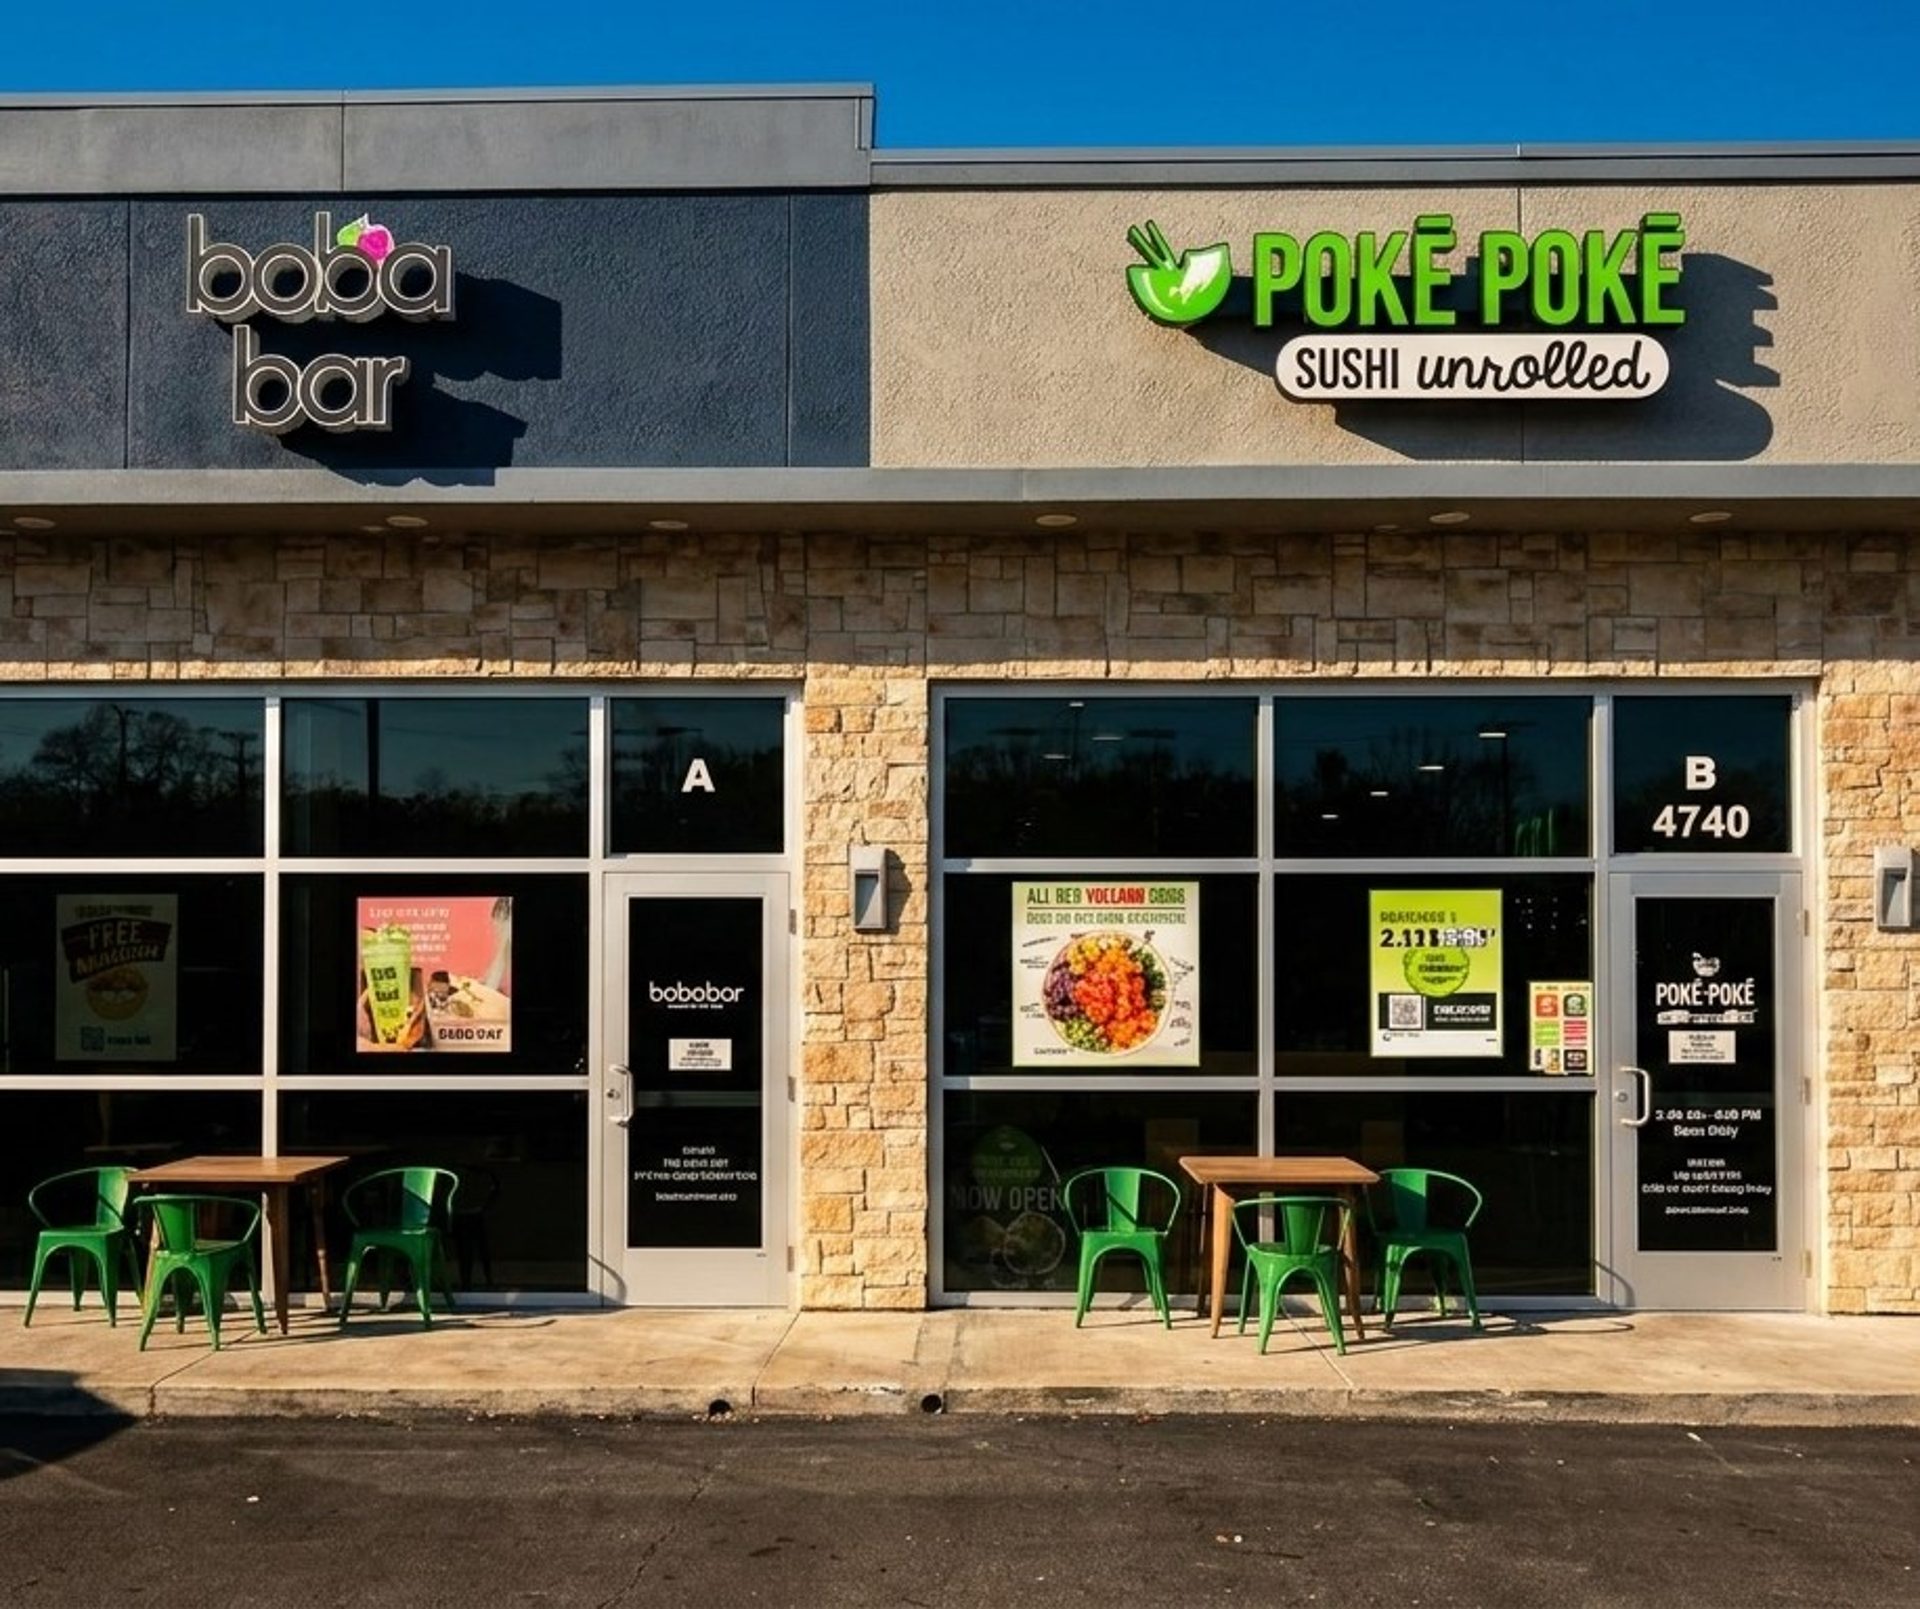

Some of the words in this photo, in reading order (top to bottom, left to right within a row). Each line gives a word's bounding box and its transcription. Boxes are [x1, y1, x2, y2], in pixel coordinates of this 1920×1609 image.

[186, 211, 454, 321] boba
[232, 324, 409, 430] bar
[1295, 347, 1399, 389] SUSHI
[1417, 340, 1651, 391] unrolled
[681, 757, 716, 793] A
[1685, 755, 1717, 790] B
[1652, 804, 1750, 839] 4740
[88, 920, 144, 950] FREE
